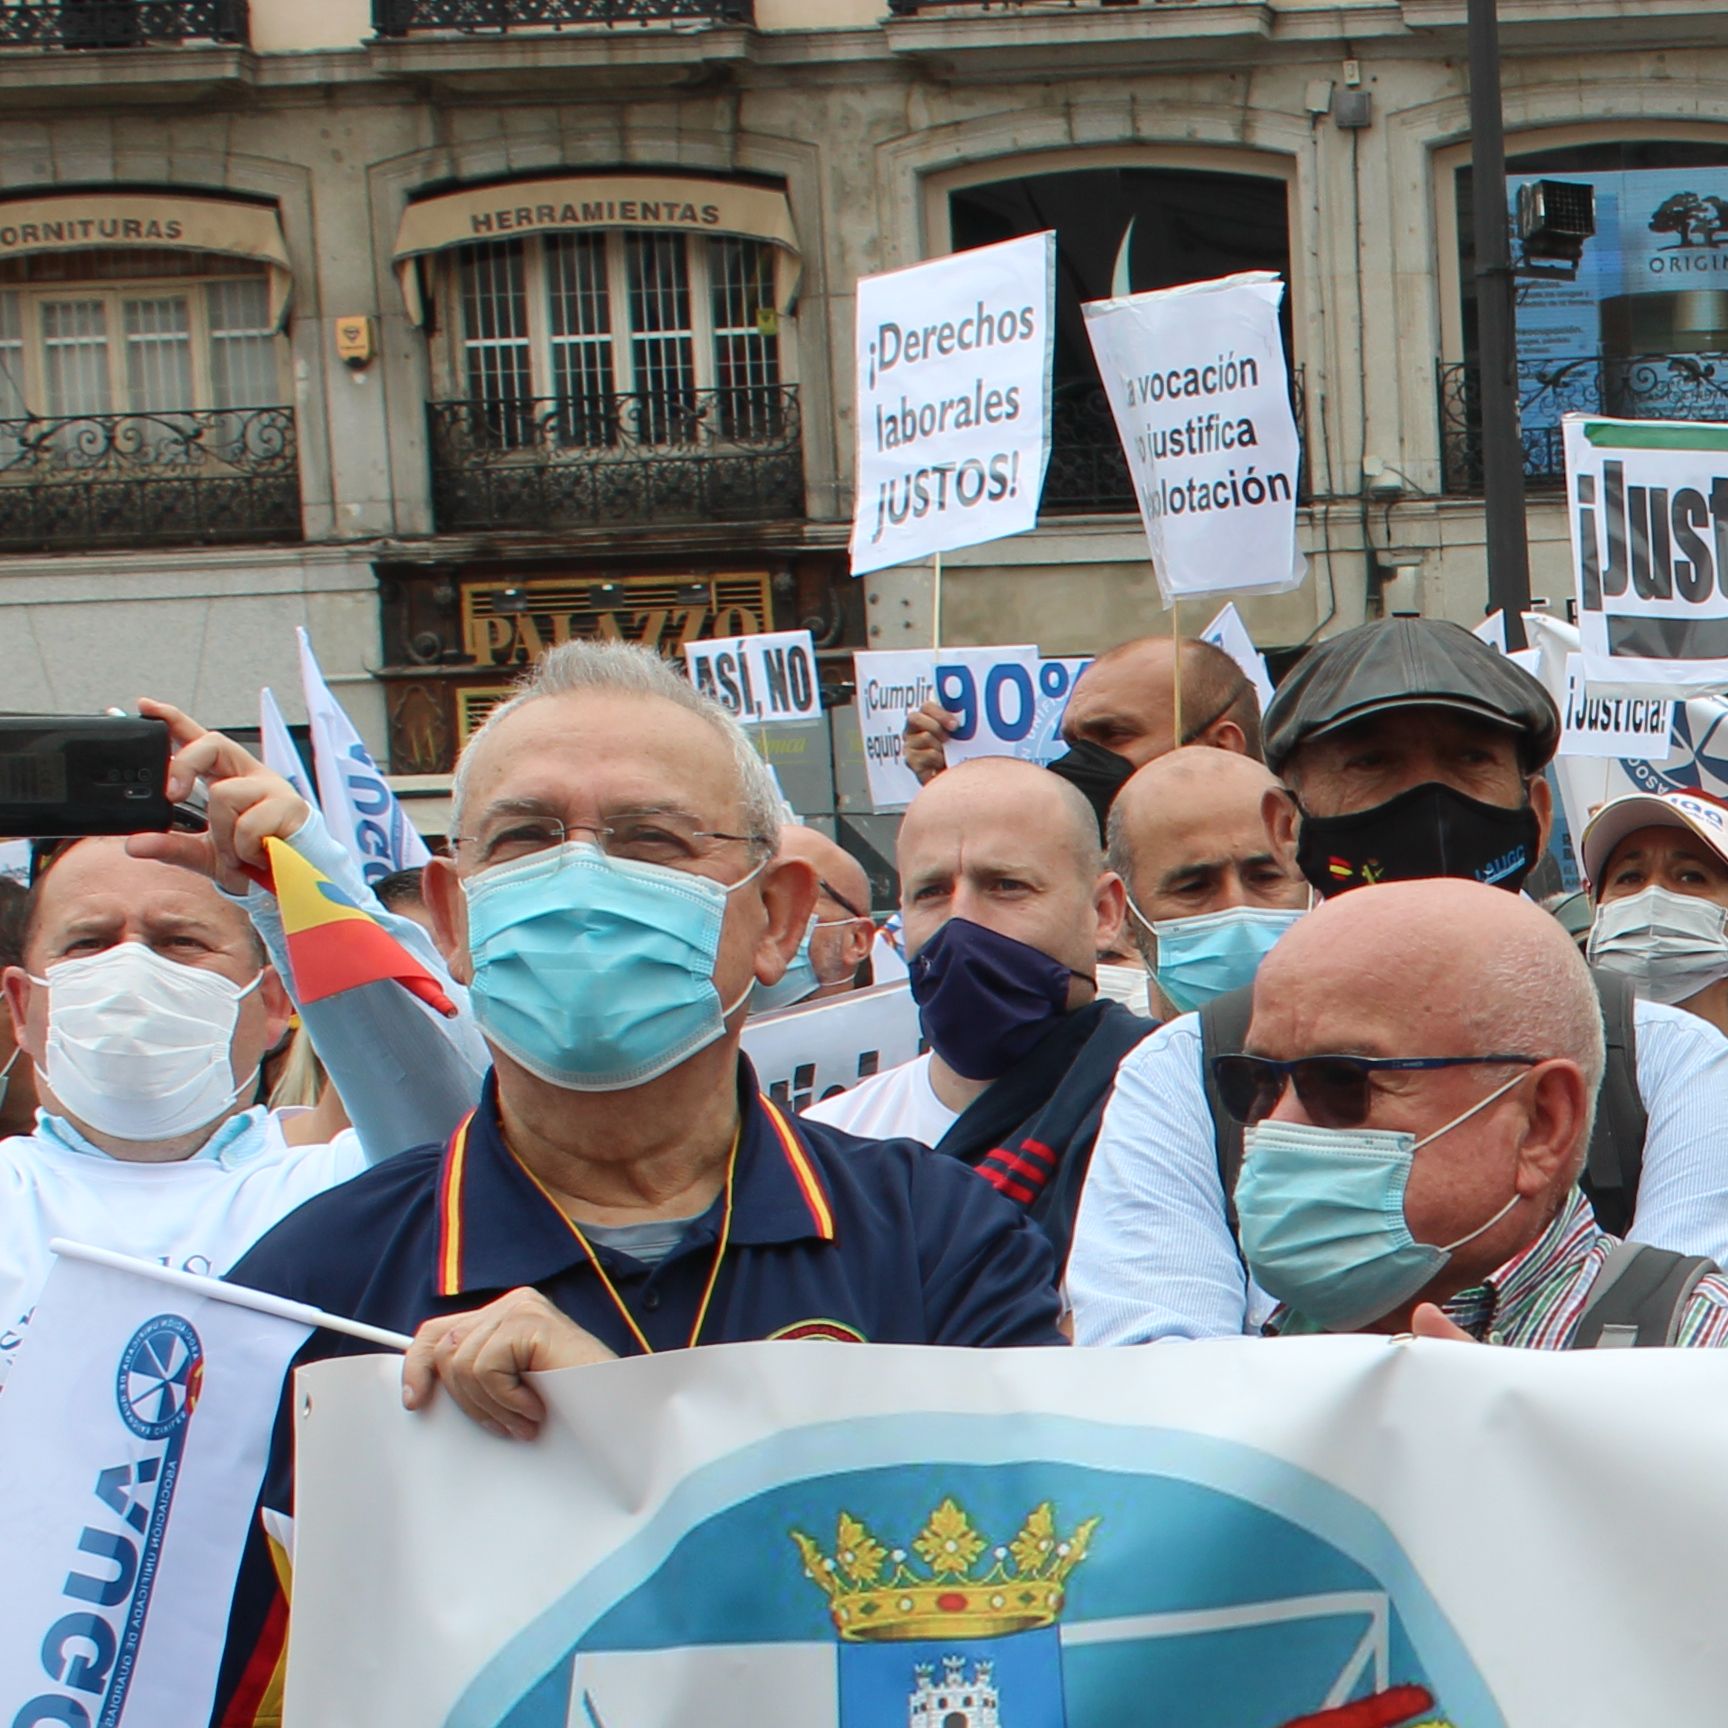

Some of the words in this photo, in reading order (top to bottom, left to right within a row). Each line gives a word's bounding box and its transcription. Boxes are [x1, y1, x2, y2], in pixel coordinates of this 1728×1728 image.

[1, 218, 184, 244] ORNITURAS
[471, 202, 721, 233] HERRAMIENTAS
[868, 302, 1036, 390] ¡Derechos
[1138, 350, 1258, 404] vocación
[875, 385, 1021, 453] laborales
[1146, 412, 1258, 460] justifica
[870, 452, 1021, 543] JUSTOS!
[763, 645, 812, 712] NO
